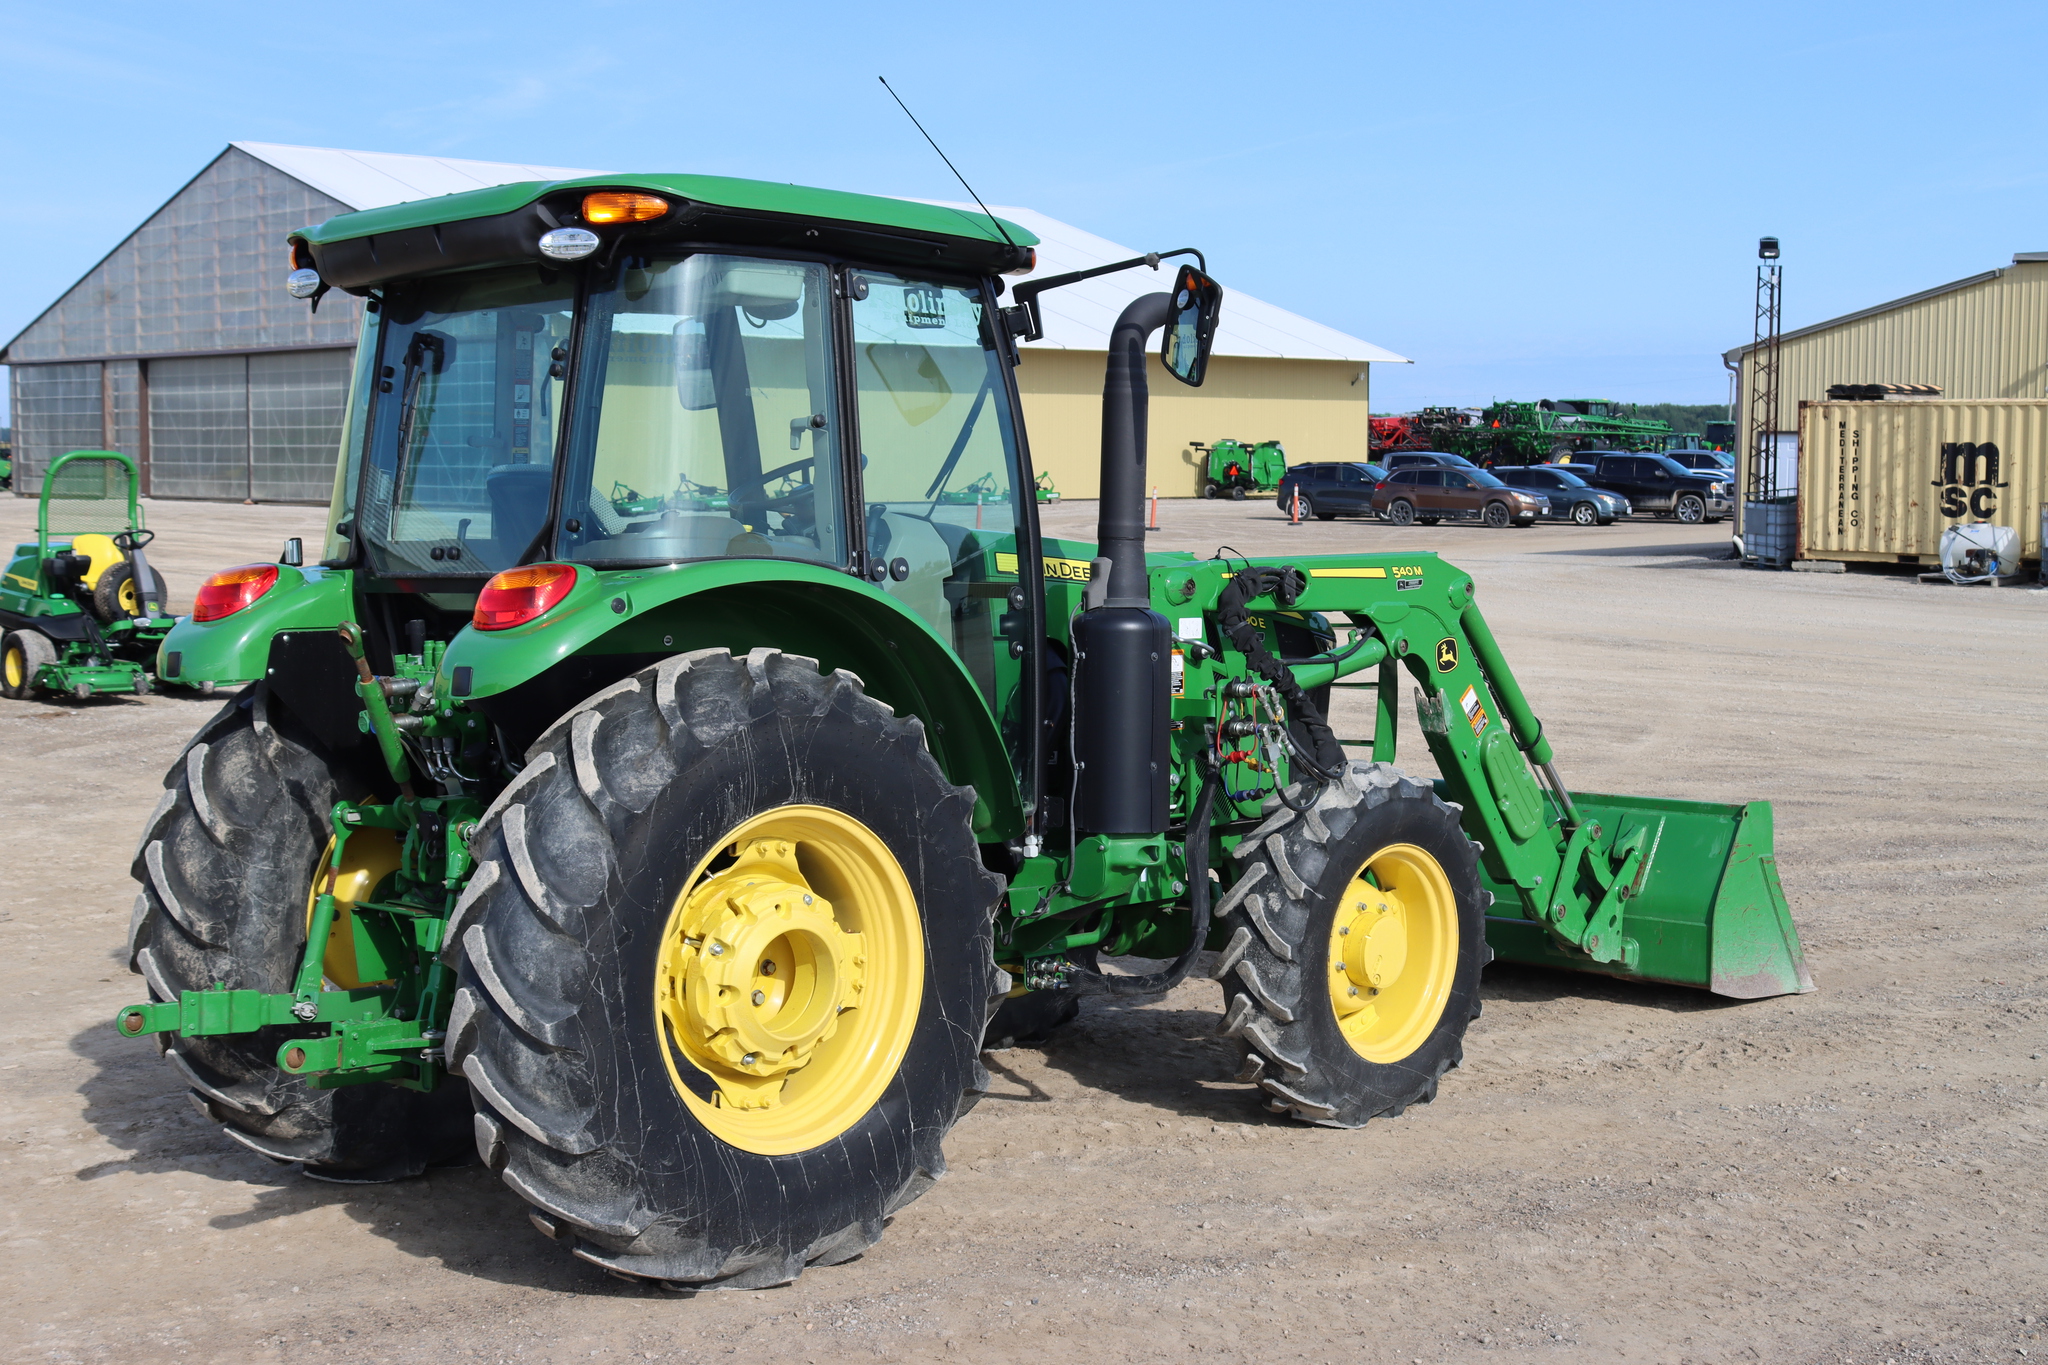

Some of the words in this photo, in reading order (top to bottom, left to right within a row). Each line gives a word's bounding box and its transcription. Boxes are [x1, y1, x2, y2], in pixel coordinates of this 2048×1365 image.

[1838, 421, 1846, 535] MEDITERRANEAN
[1851, 430, 1859, 500] SHIPPING
[1850, 510, 1858, 527] CO
[1059, 562, 1091, 579] DEE
